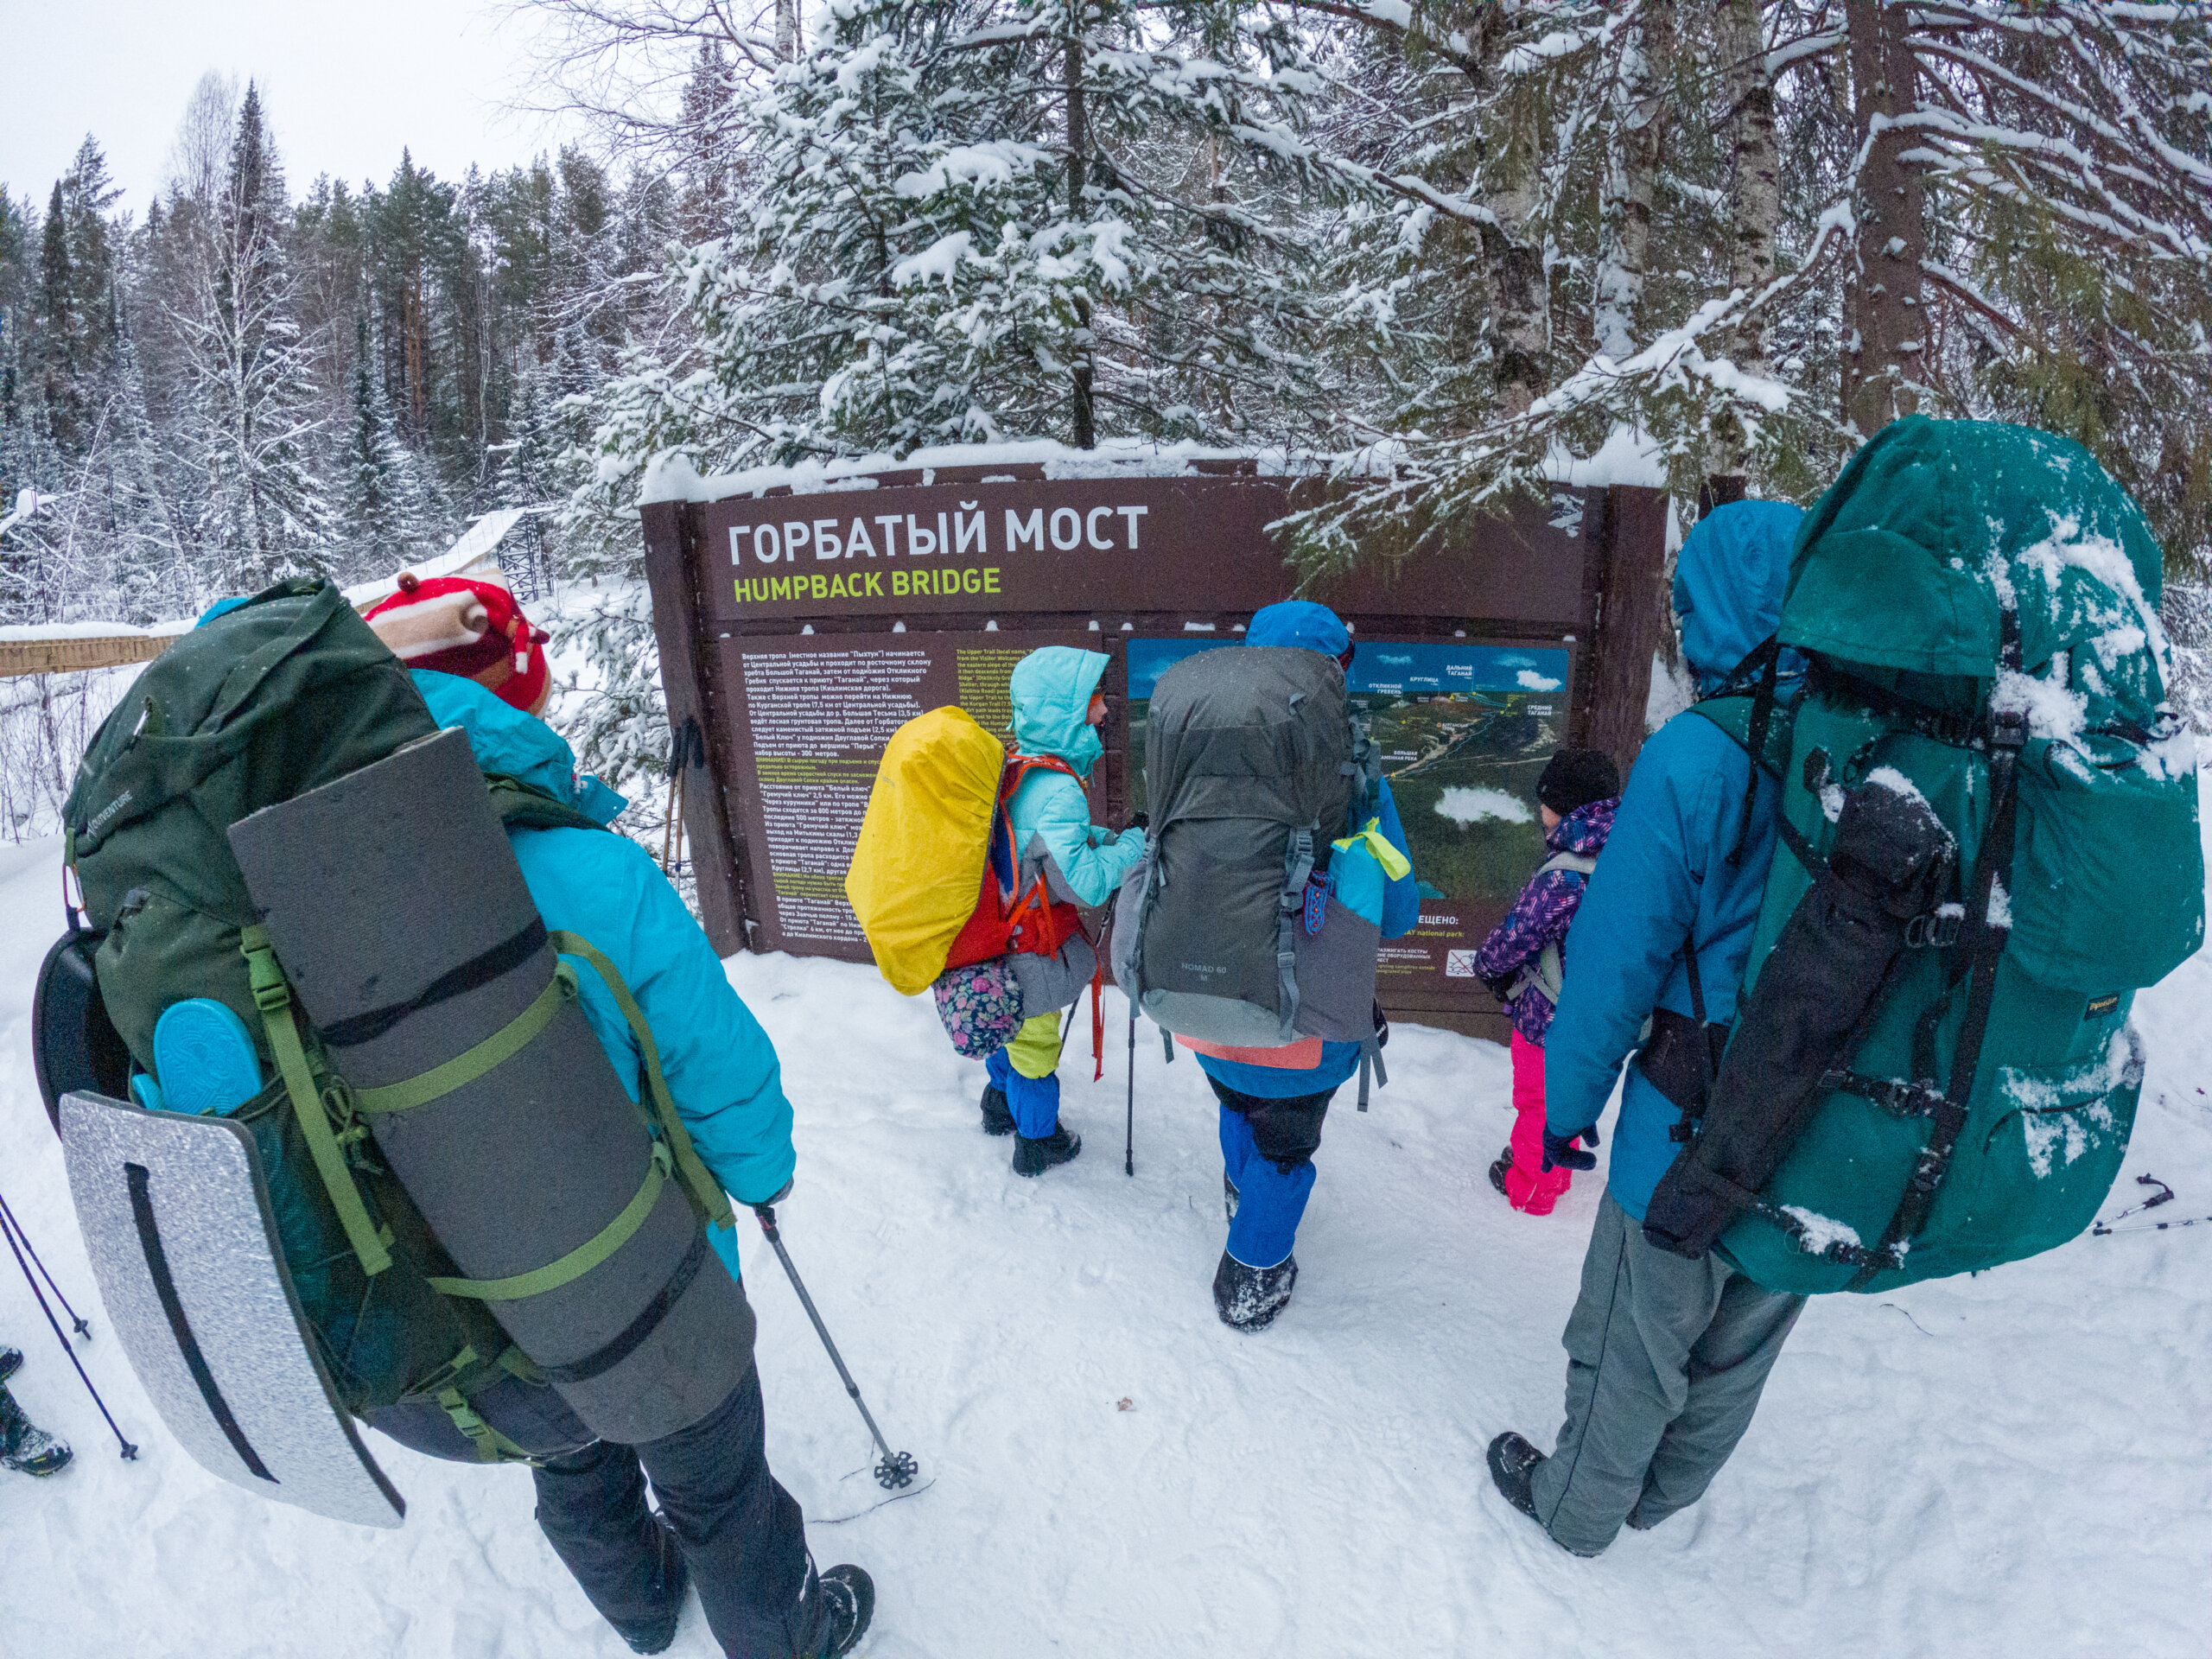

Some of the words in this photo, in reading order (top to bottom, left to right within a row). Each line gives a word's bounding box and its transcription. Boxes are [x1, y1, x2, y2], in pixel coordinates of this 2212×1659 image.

[728, 500, 987, 565] ГОРБАТЫЙ
[1005, 505, 1149, 552] МОСТ
[734, 571, 885, 603] HUMPBACK
[892, 568, 1001, 597] BRIDGE
[742, 652, 767, 661] Верхняя
[1418, 915, 1459, 925] ЕЩЕНО:
[1181, 963, 1214, 973] NOMAD
